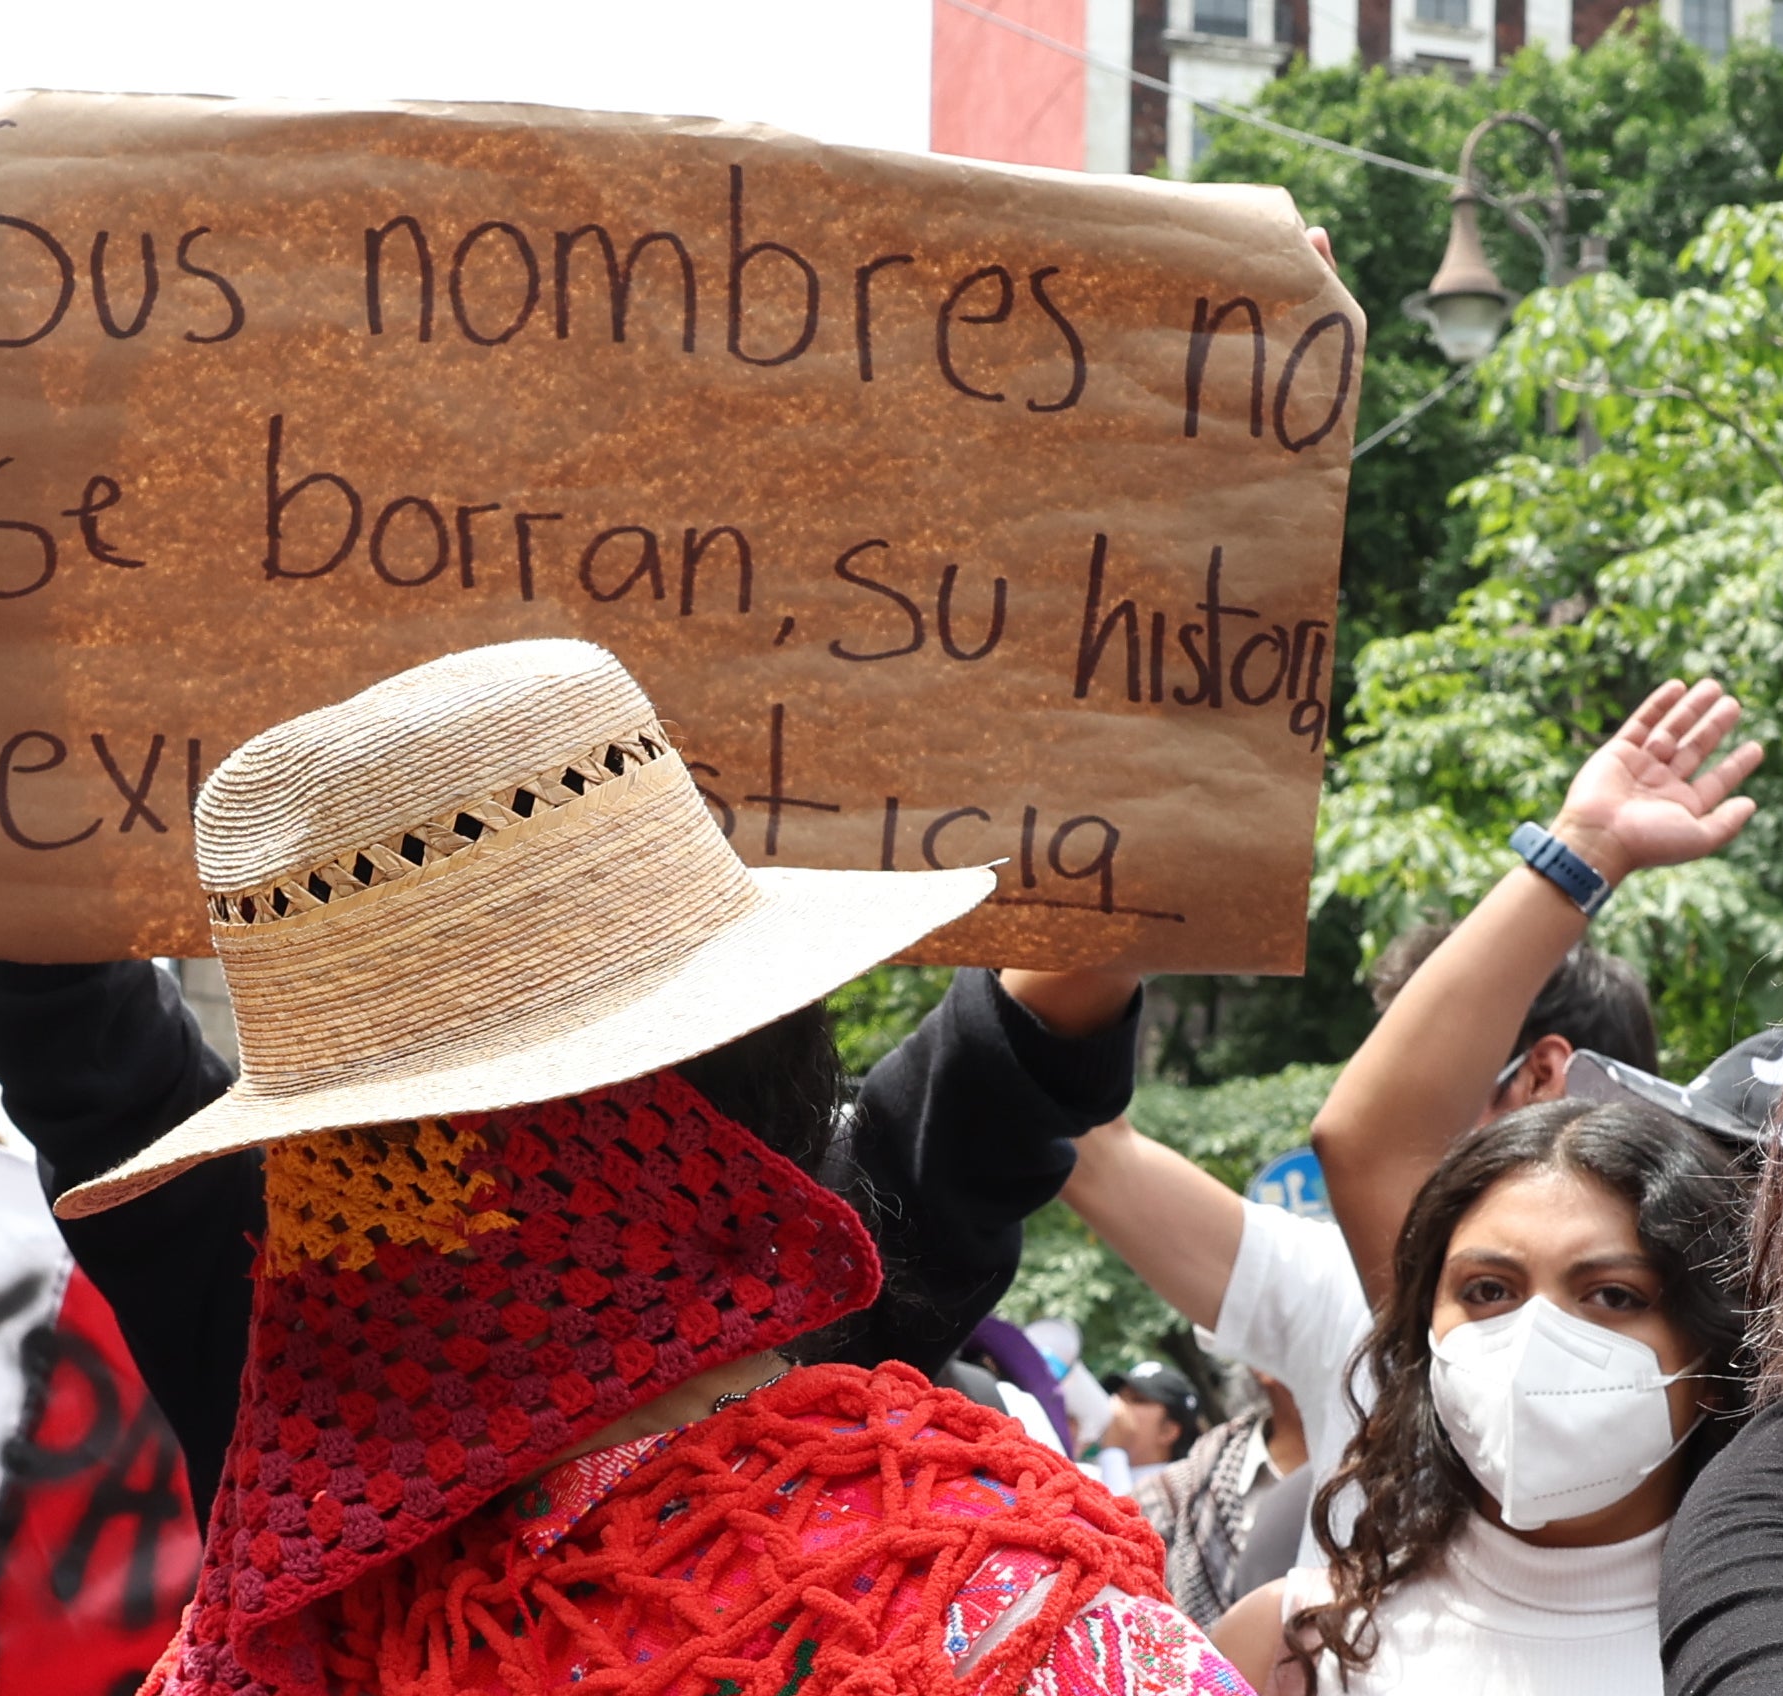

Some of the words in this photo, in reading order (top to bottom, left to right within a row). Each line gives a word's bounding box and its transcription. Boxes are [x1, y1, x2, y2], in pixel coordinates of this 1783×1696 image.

[364, 164, 1088, 413] nombres
[1183, 295, 1356, 453] no
[263, 413, 796, 647] borran,
